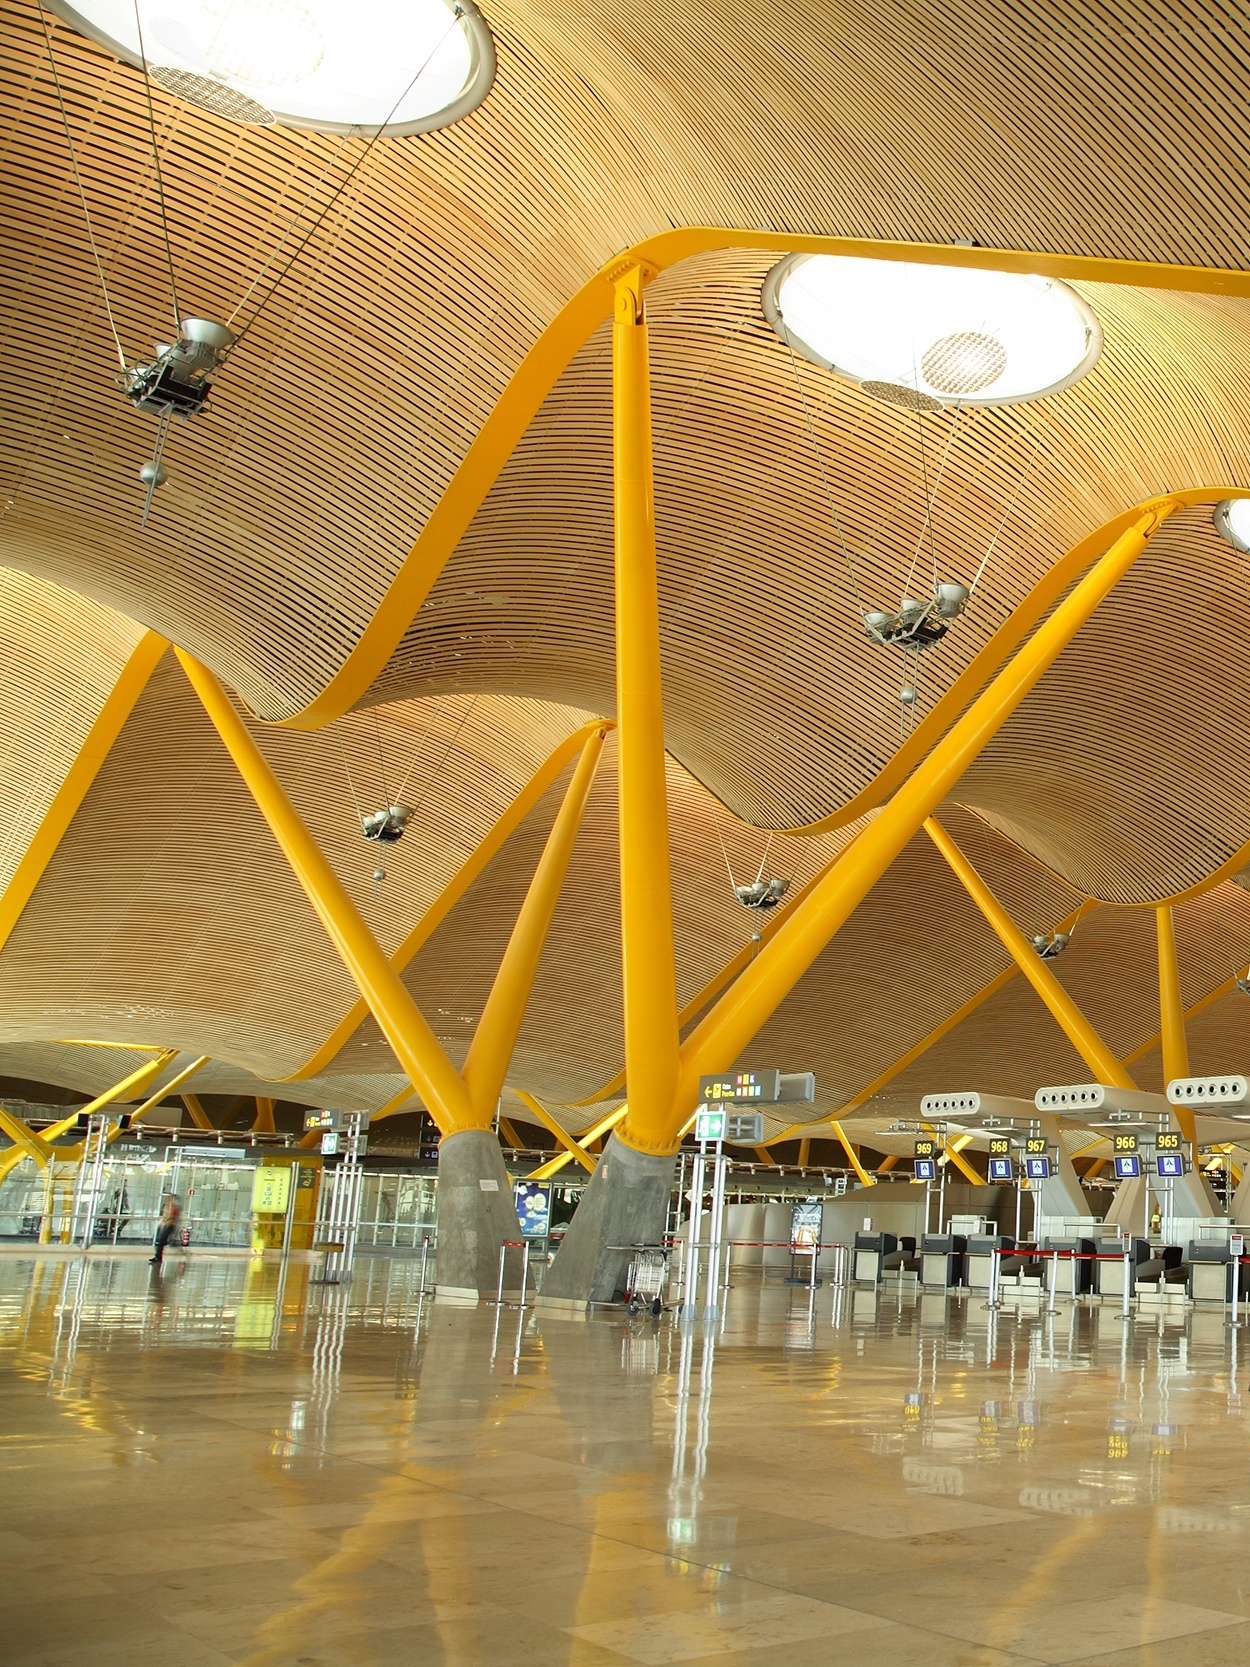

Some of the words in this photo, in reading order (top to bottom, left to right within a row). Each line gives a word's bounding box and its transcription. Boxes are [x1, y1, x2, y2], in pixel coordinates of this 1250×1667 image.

[916, 1142, 932, 1154] 969
[990, 1141, 1008, 1152] 968
[1027, 1139, 1045, 1152] 967
[1116, 1136, 1135, 1149] 966
[1158, 1135, 1178, 1148] 965
